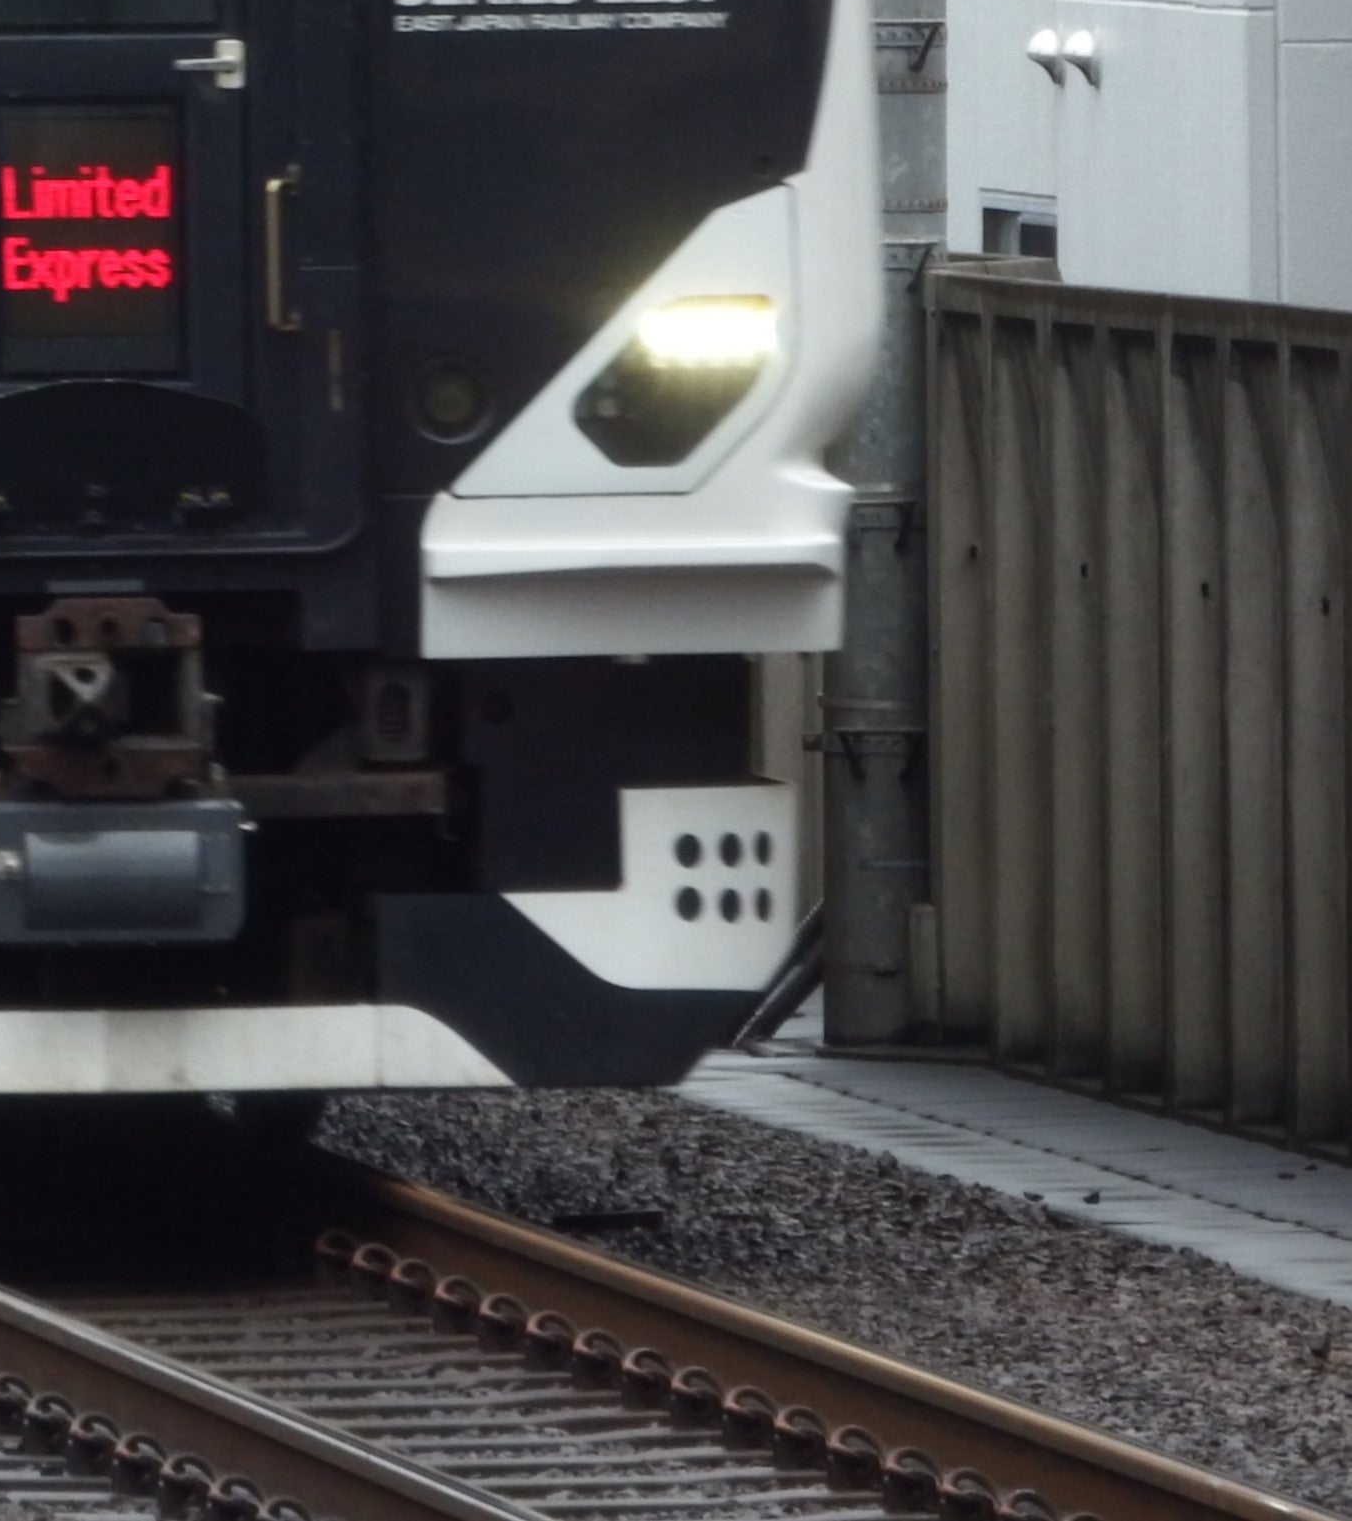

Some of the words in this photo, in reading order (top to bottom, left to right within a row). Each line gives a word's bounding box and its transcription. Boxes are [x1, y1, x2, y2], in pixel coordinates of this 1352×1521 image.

[394, 15, 454, 32] EAST
[457, 14, 524, 31] JAPAN
[531, 13, 616, 30] RAILWAY
[623, 12, 731, 30] COMPANY
[0, 165, 172, 220] Limited
[1, 237, 173, 303] Express
